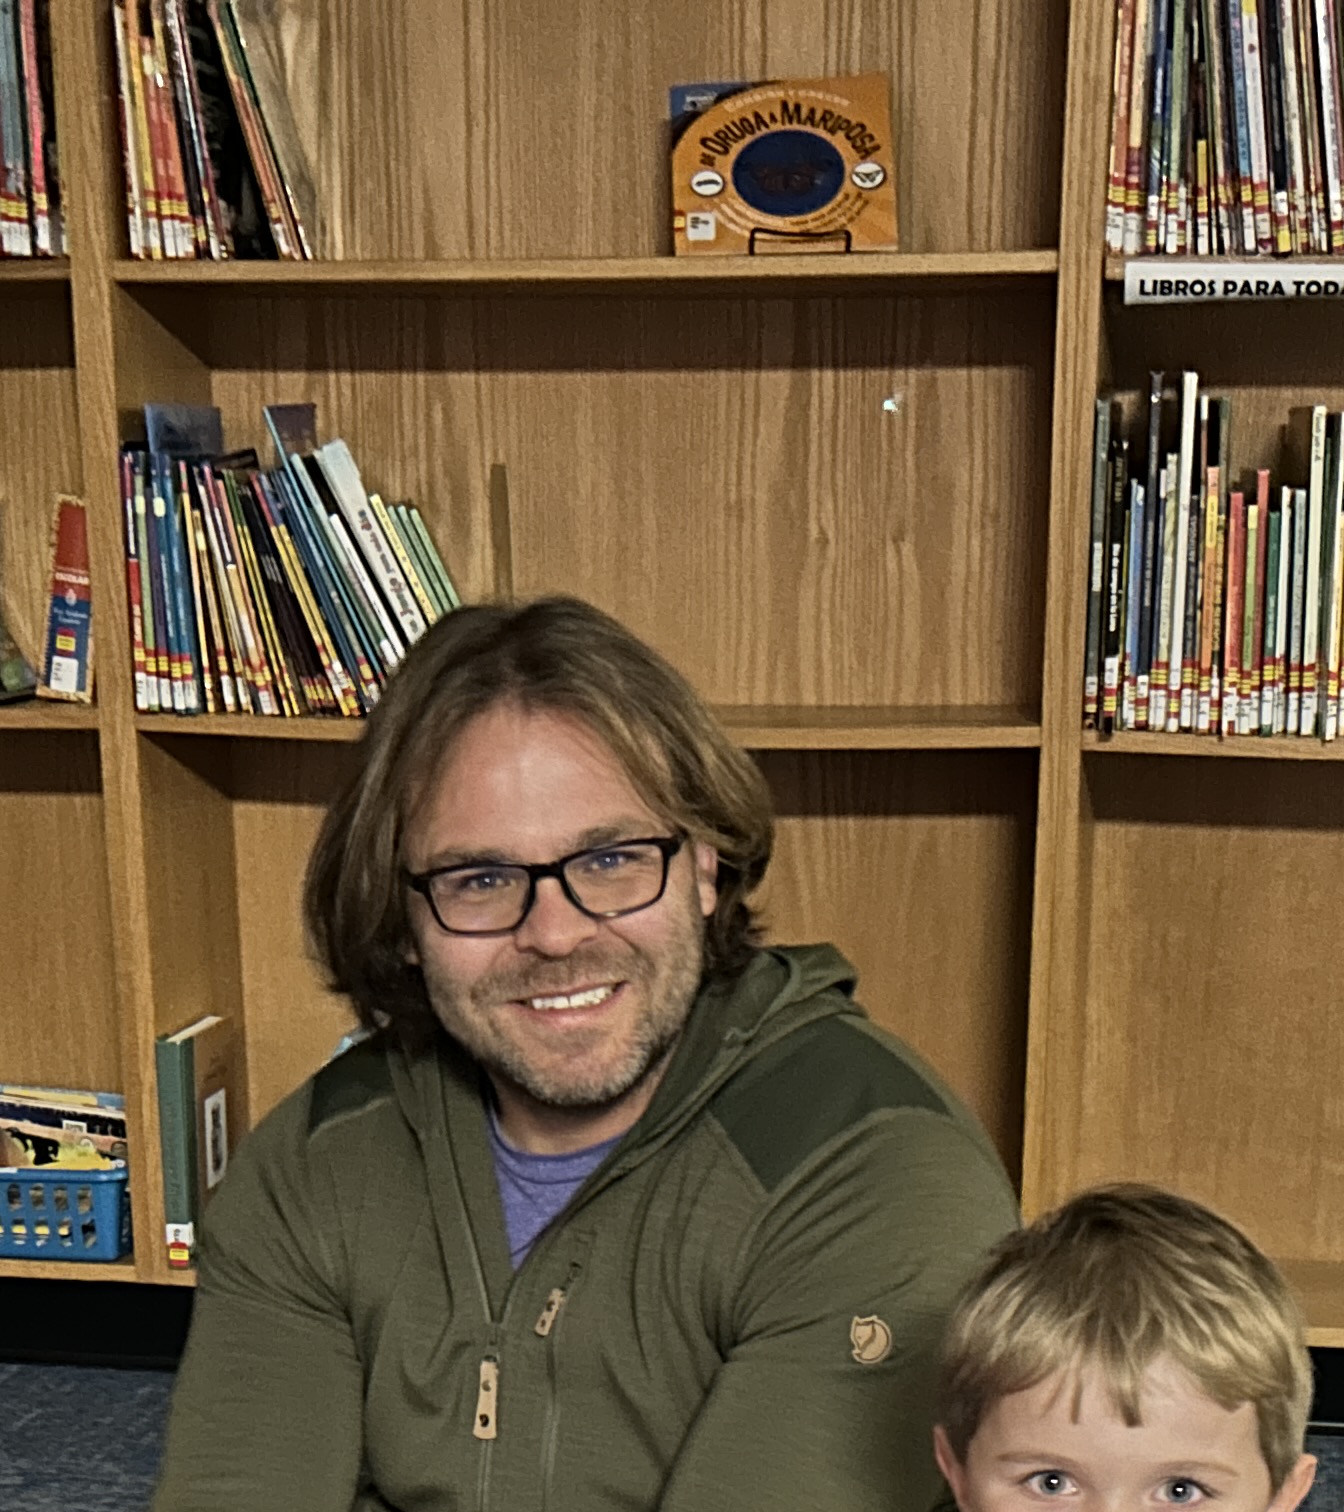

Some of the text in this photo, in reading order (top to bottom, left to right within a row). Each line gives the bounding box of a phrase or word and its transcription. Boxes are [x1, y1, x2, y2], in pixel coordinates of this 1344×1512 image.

[699, 110, 770, 157] ORUGA
[780, 99, 882, 160] MARIPOSA
[1138, 279, 1216, 297] LIBROS
[1222, 279, 1286, 297] PARA
